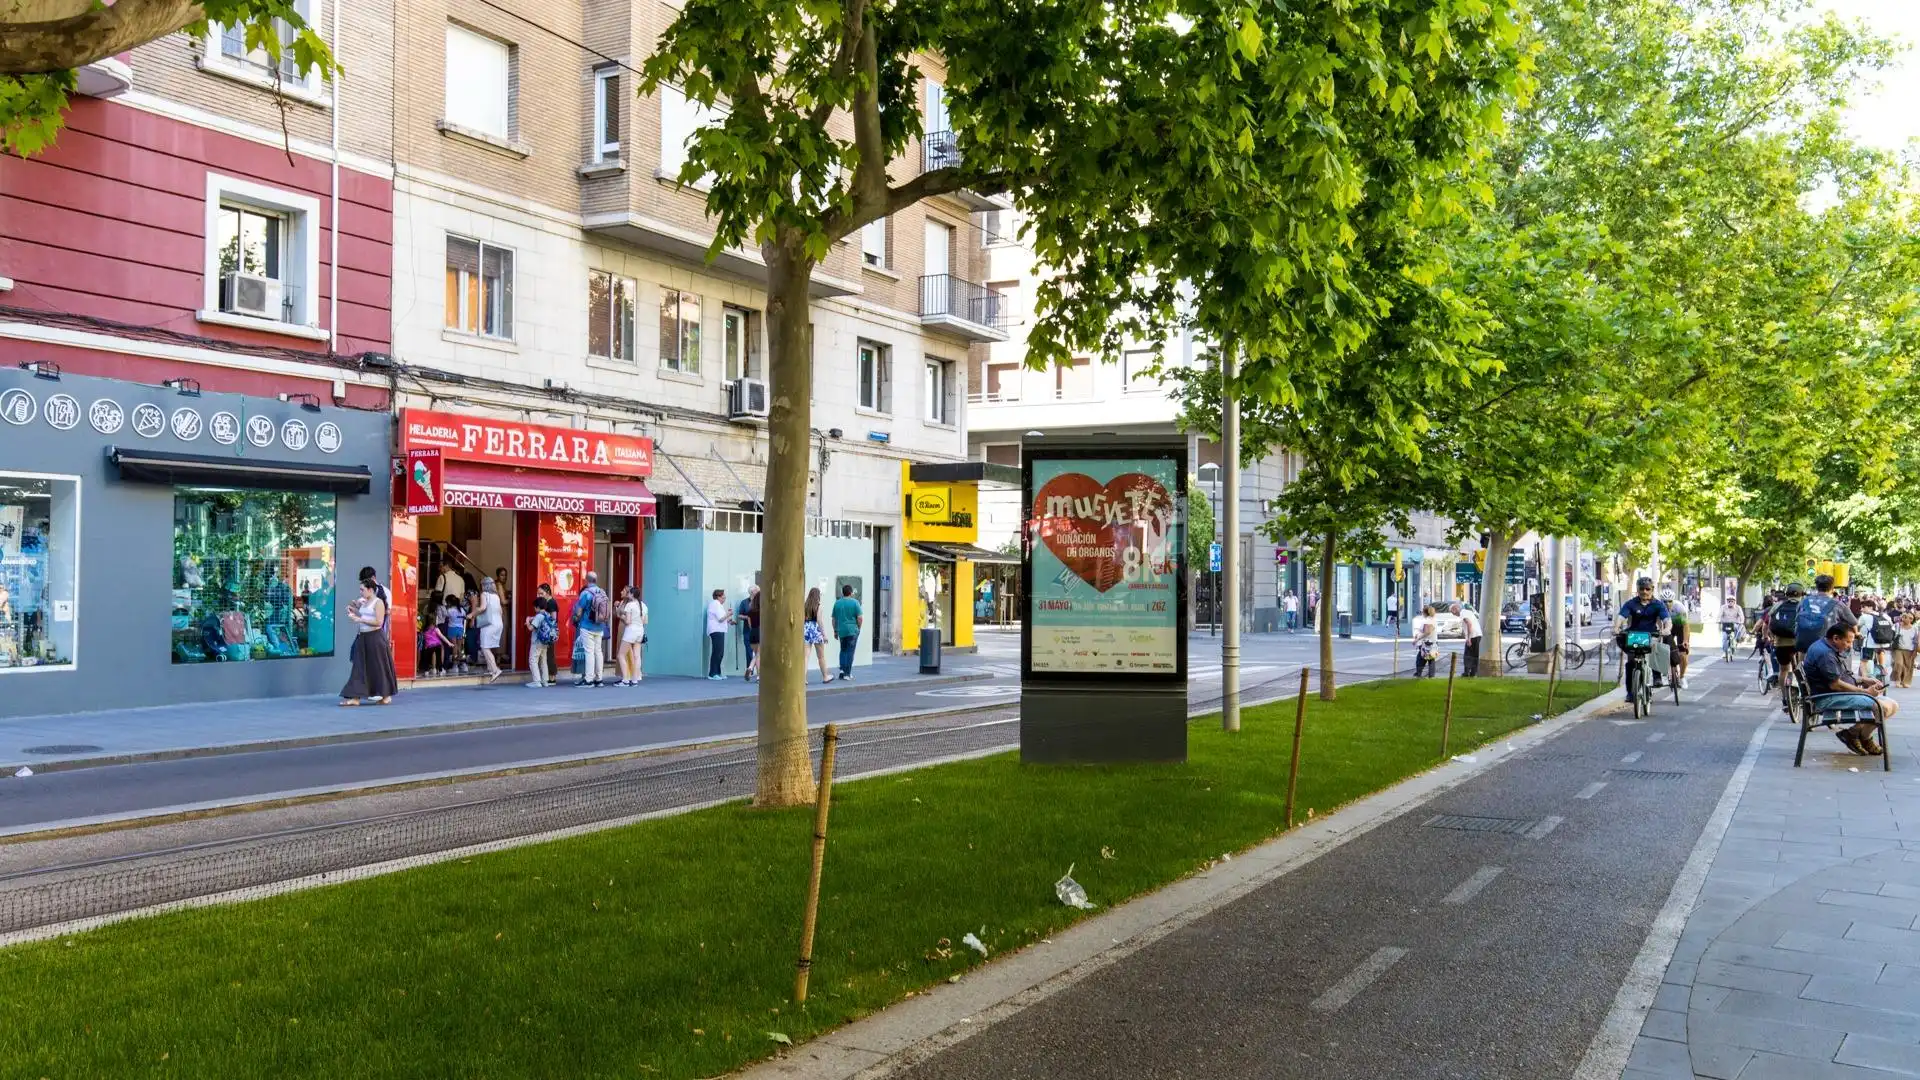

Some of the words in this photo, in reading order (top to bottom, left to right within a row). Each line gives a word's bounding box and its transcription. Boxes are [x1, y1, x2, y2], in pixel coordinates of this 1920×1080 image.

[409, 423, 458, 440] HELADERIA
[461, 423, 610, 466] FERRARA
[614, 447, 648, 460] ITALIANA
[410, 449, 440, 457] FERRARA
[408, 505, 439, 513] HELADERIA
[442, 490, 504, 508] ORCHATA
[514, 494, 585, 512] GRANIZADOS
[594, 500, 641, 515] HELADOS
[1056, 532, 1097, 545] DONACIÓN
